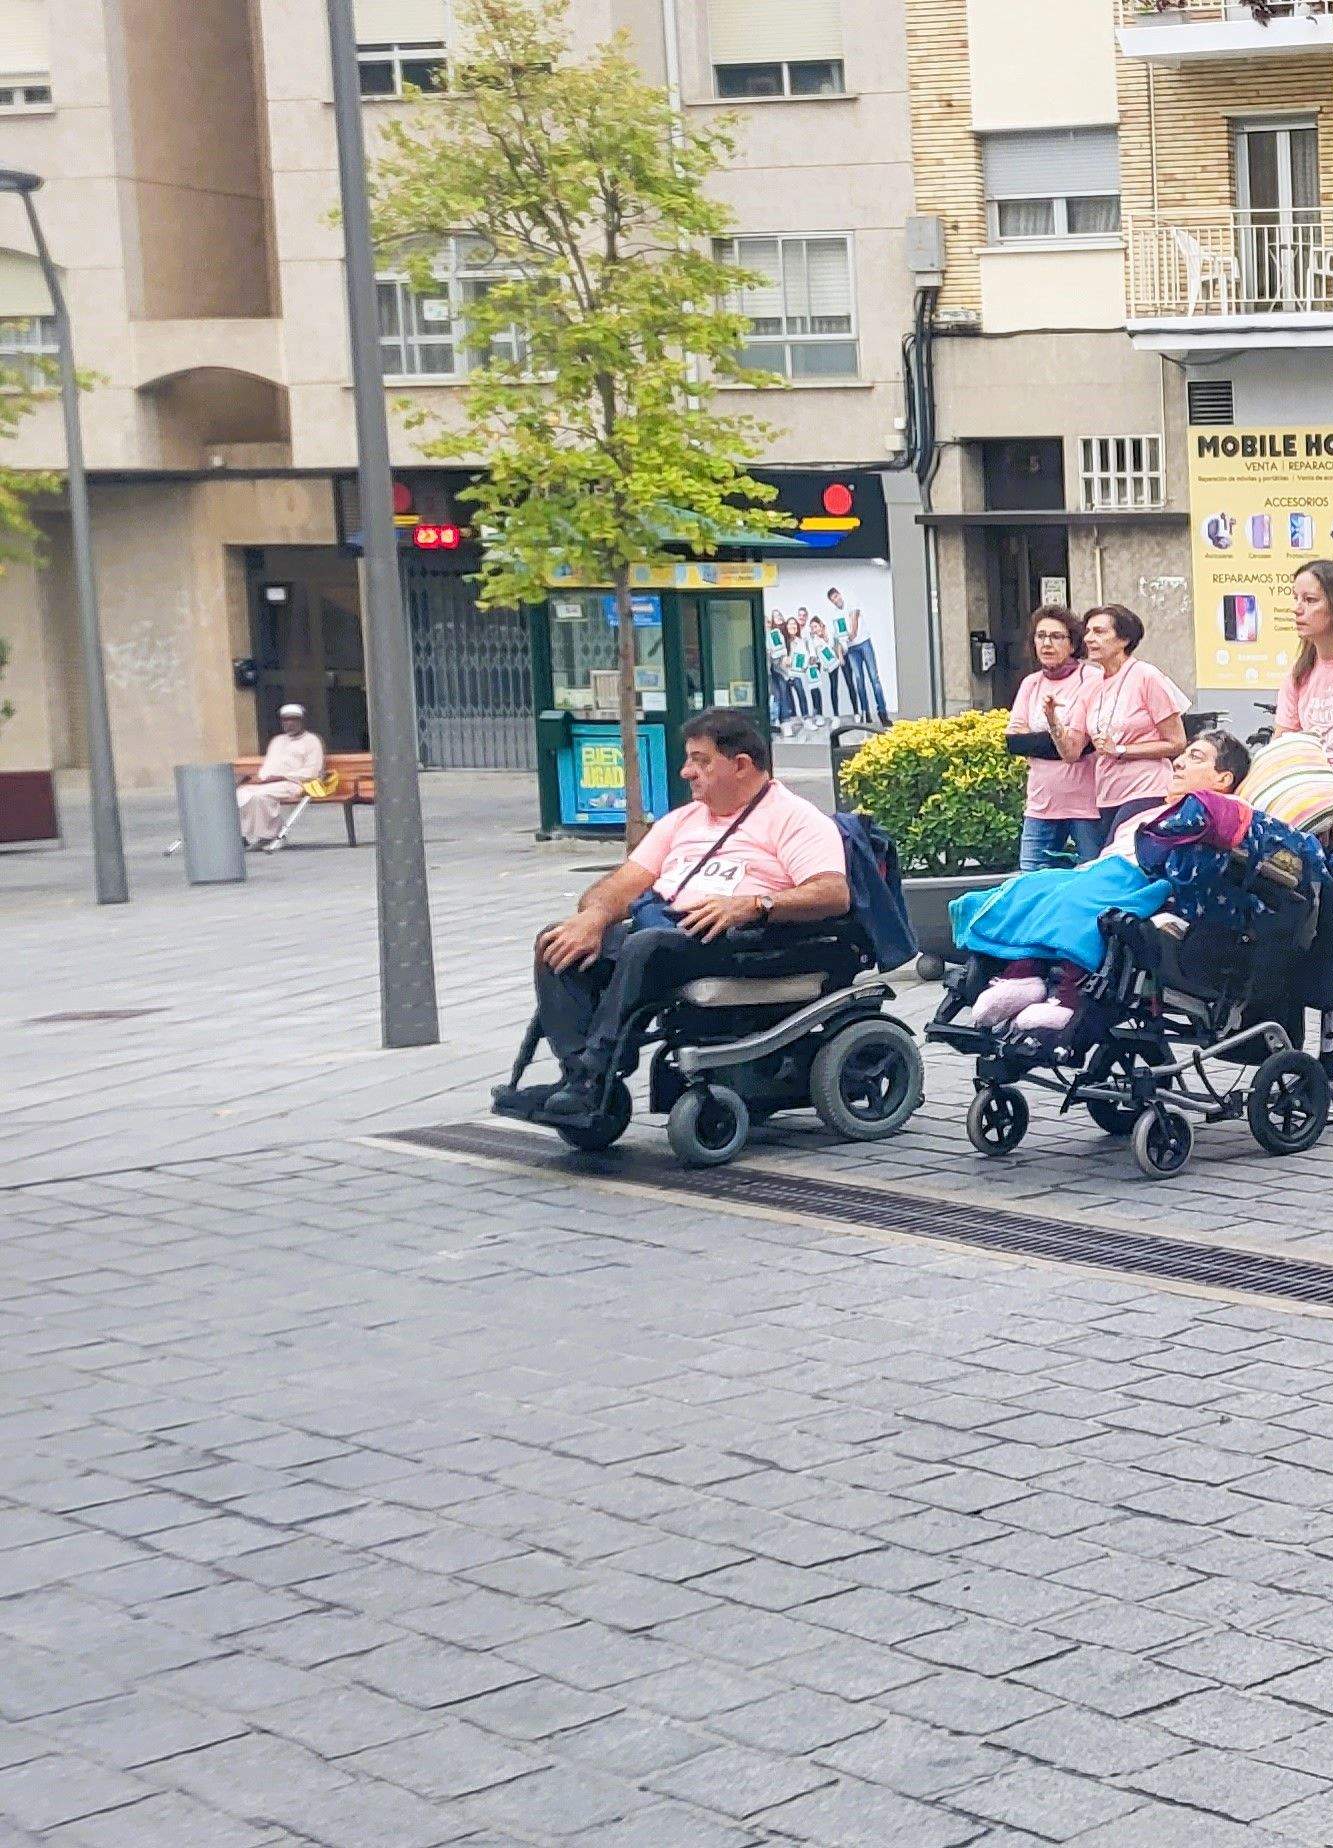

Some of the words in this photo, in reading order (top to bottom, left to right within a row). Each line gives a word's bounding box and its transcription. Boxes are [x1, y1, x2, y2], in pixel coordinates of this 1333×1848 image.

[1197, 434, 1298, 458] MOBILE
[1245, 461, 1278, 472] VENTA
[1264, 496, 1329, 508] ACCESORIOS
[1212, 573, 1274, 584] REPARAMOS
[580, 765, 626, 789] JUGAD
